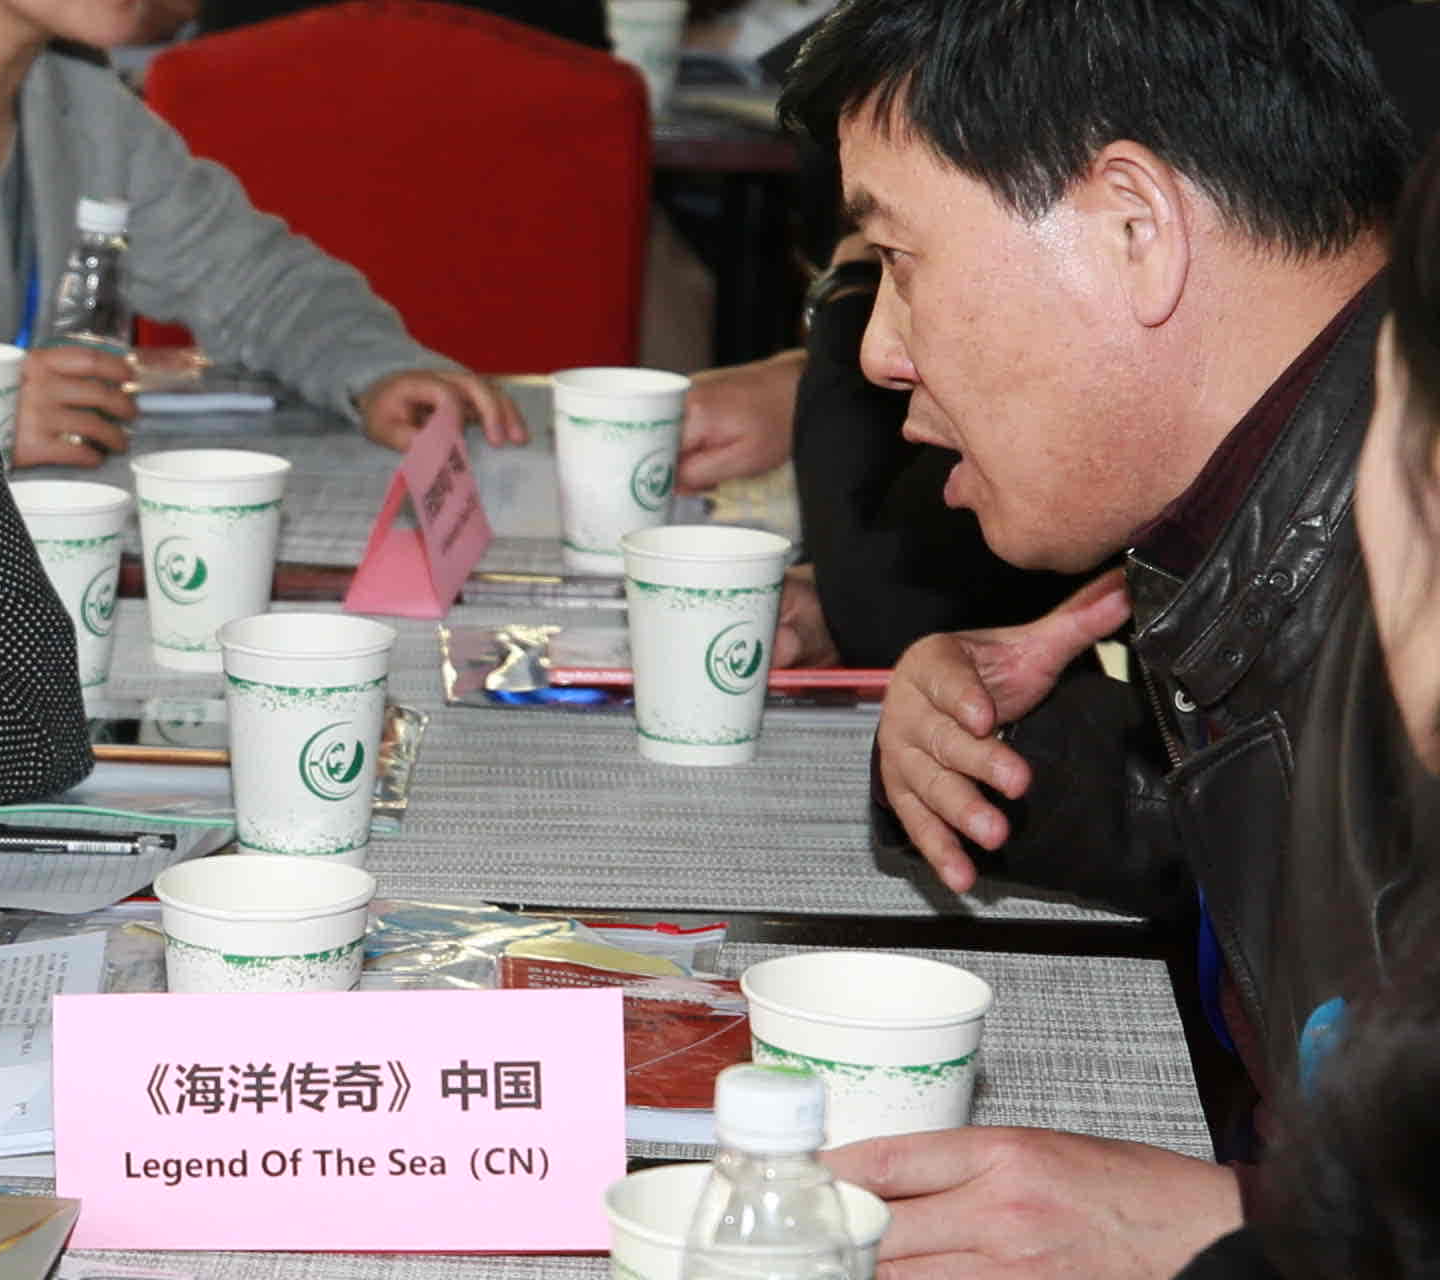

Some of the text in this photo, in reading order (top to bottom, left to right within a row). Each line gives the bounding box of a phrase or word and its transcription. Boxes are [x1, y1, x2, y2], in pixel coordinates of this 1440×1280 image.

[146, 1058, 543, 1115] 《海洋传奇》 中国
[124, 1146, 550, 1187] Legend Of The Sea (CN)
